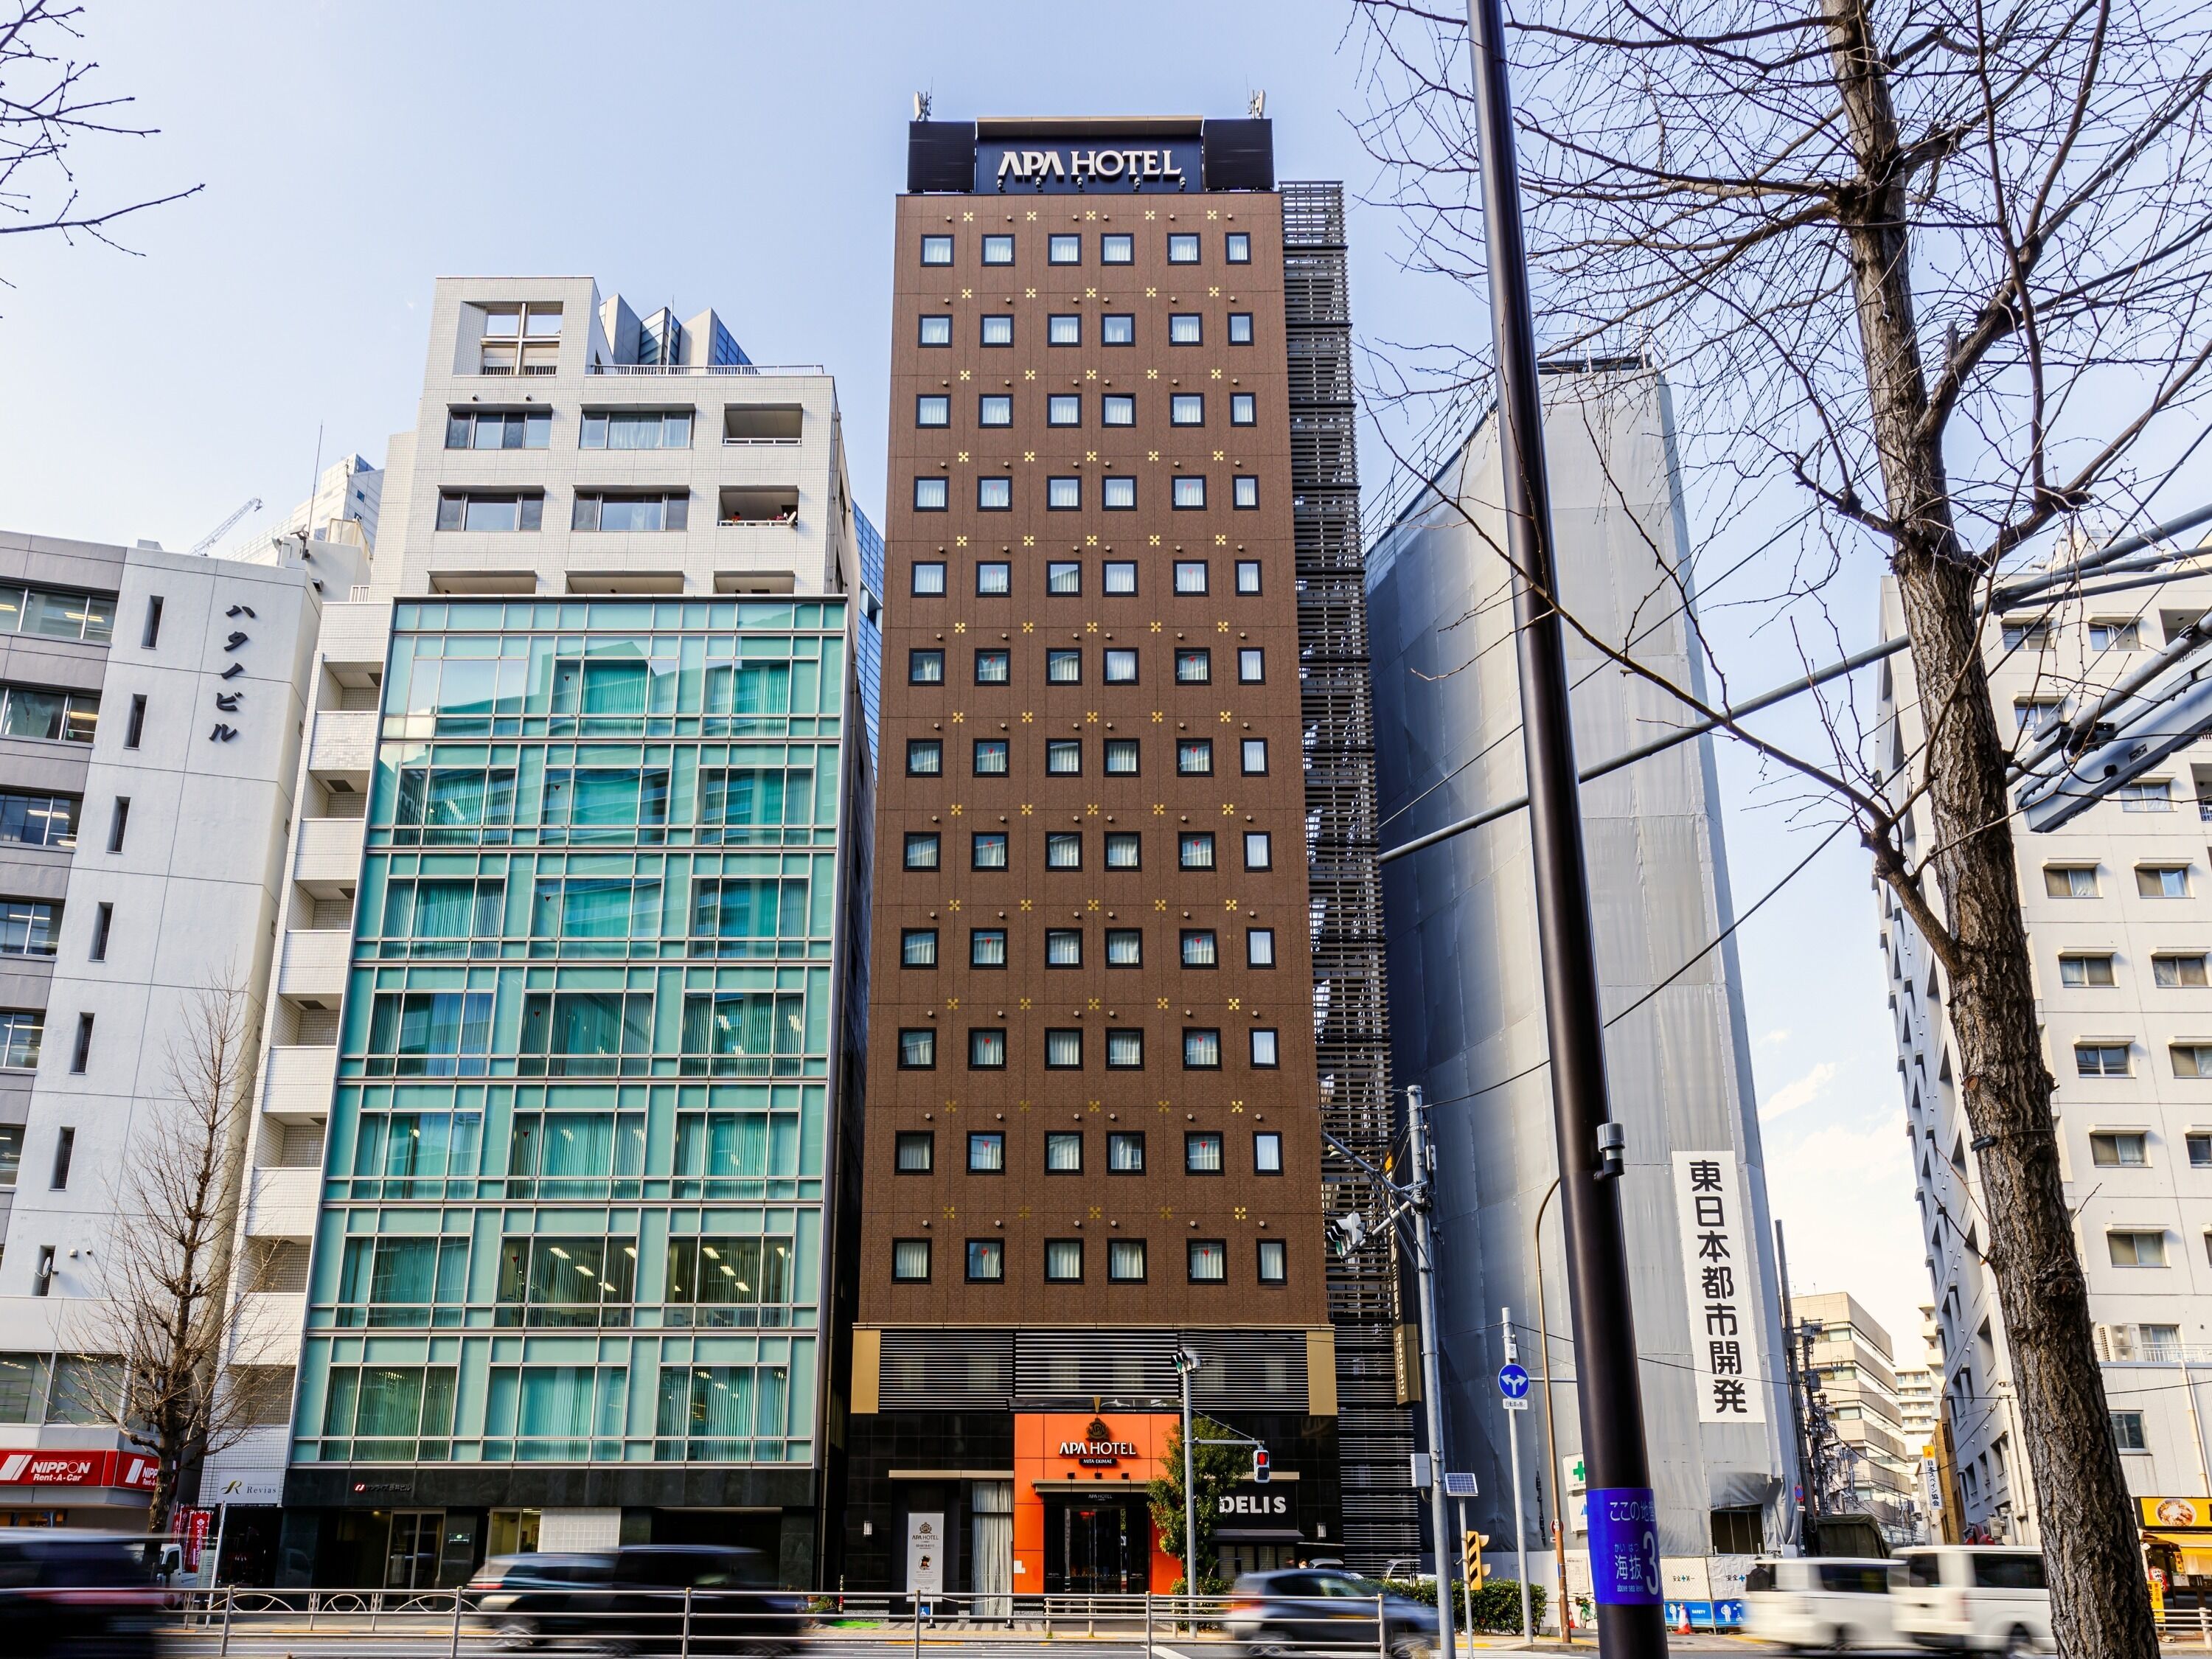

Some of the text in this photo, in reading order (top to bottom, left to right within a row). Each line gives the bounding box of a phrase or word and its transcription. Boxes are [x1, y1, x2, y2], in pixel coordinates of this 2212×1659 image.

[998, 150, 1182, 177] APA HOTEL
[209, 605, 256, 742] ハタノビル
[1689, 1160, 1747, 1413] 東日本都市開発
[1059, 1442, 1136, 1455] APA HOTEL
[30, 1461, 91, 1474] NIPPON
[142, 1467, 158, 1478] NIPP
[247, 1486, 276, 1494] Revias
[1927, 1461, 1940, 1506] 日本スペイン協会
[1615, 1554, 1643, 1579] 海抜
